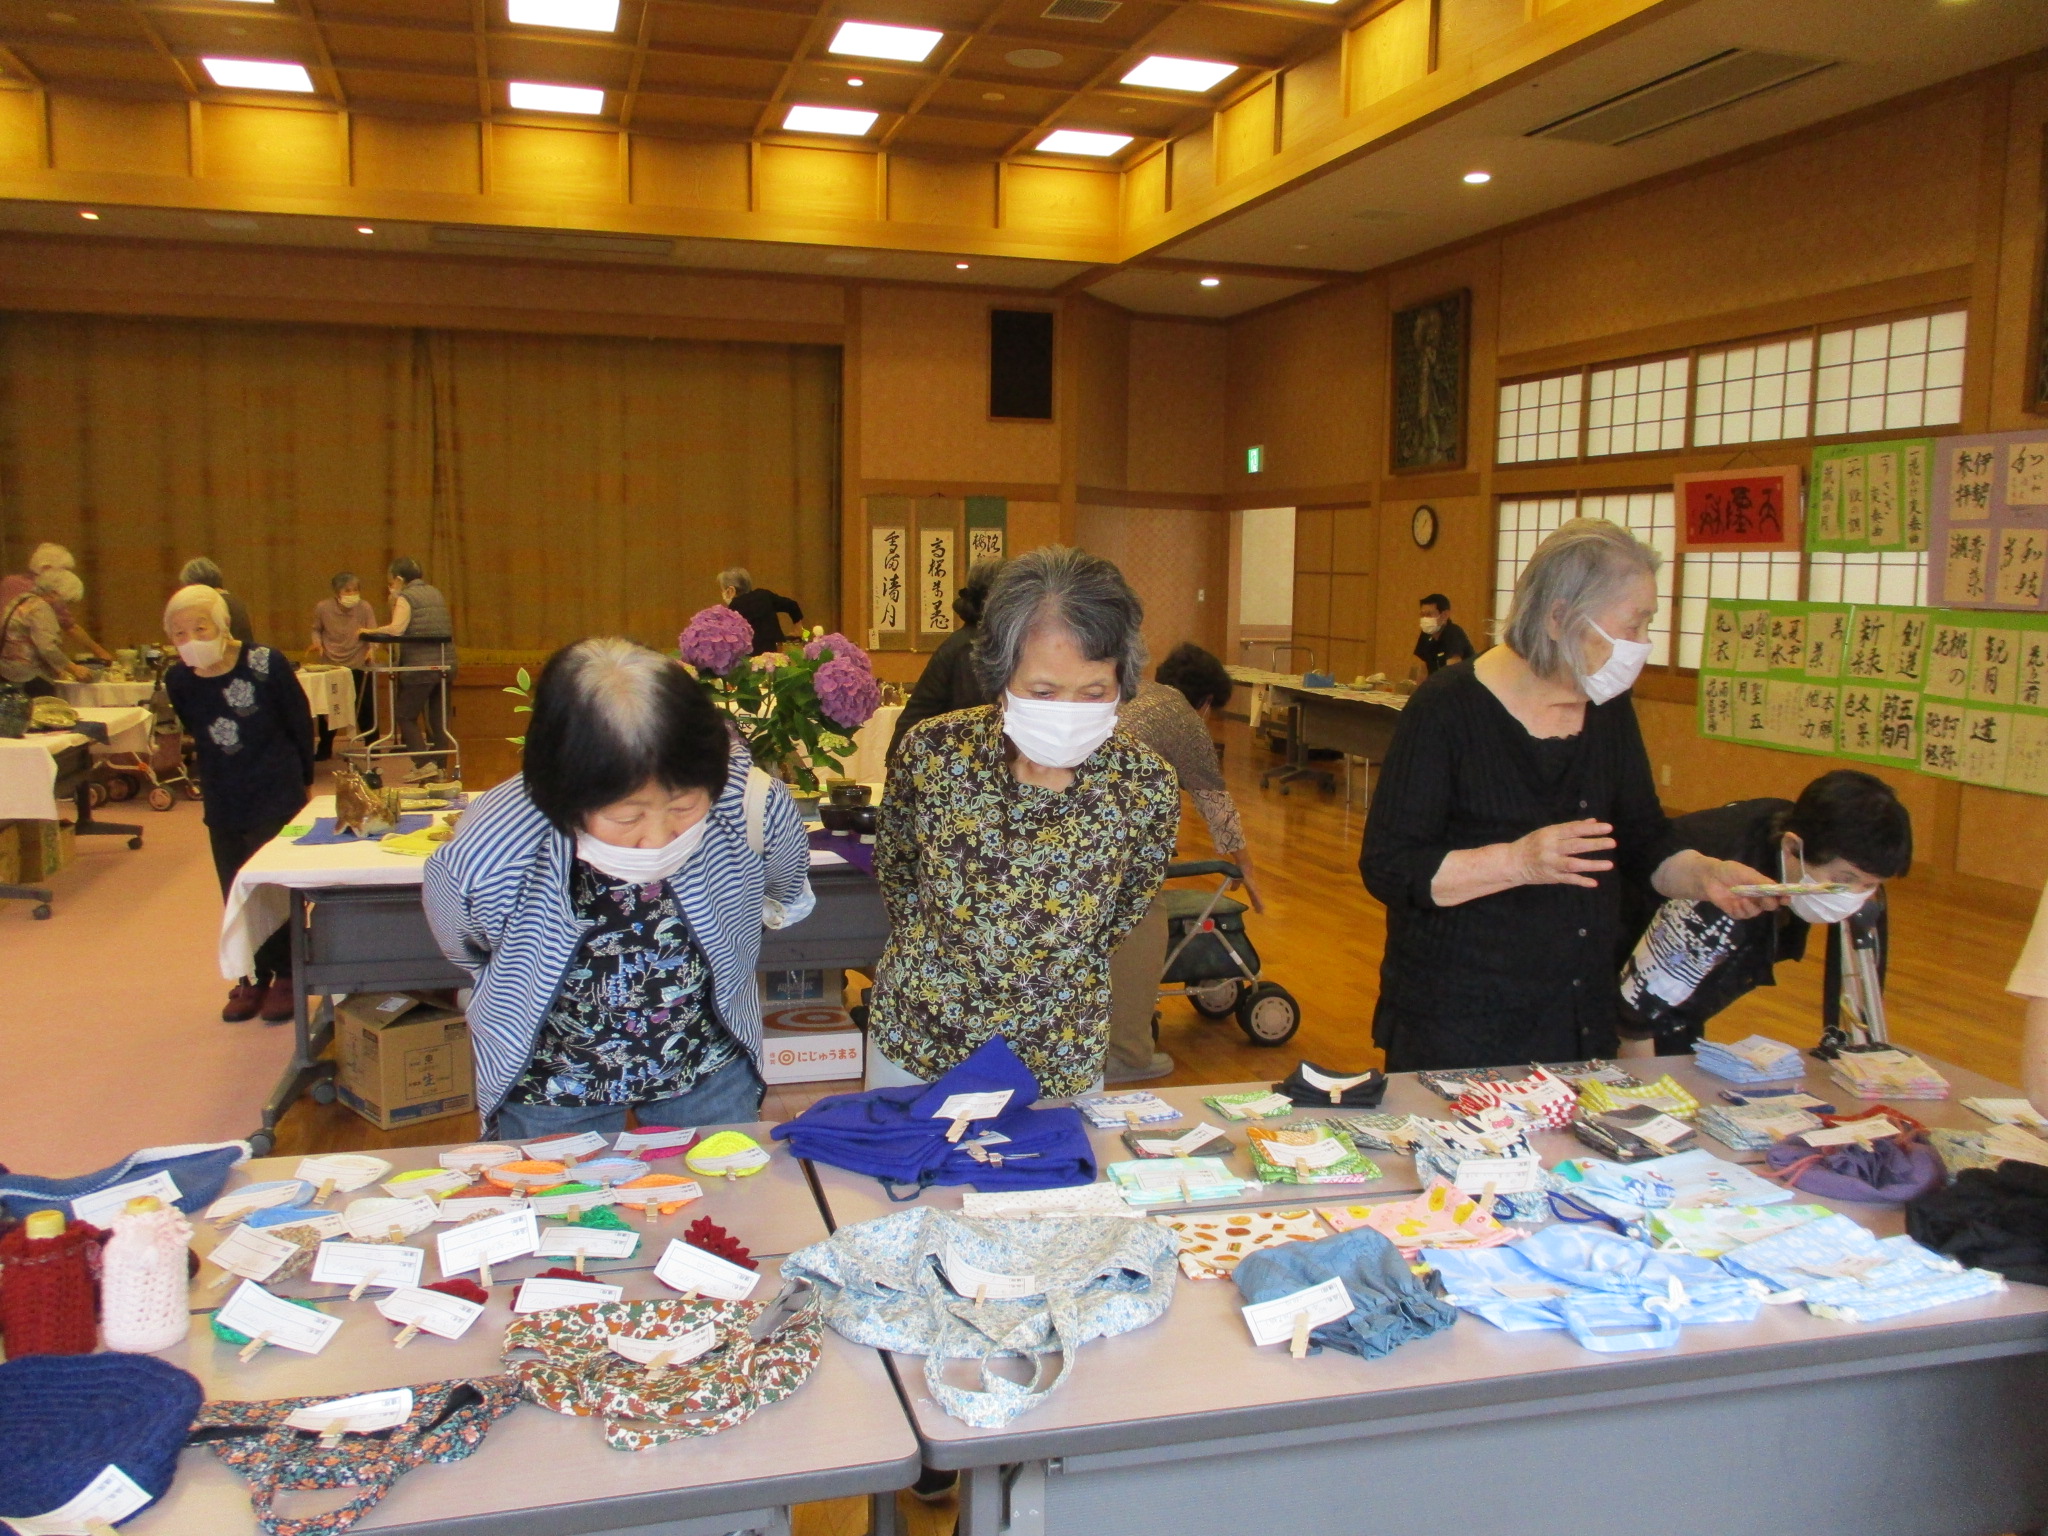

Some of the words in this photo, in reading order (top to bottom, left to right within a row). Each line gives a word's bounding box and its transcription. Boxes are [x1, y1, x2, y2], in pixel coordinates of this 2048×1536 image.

[797, 1048, 857, 1062] にじゅうまる
